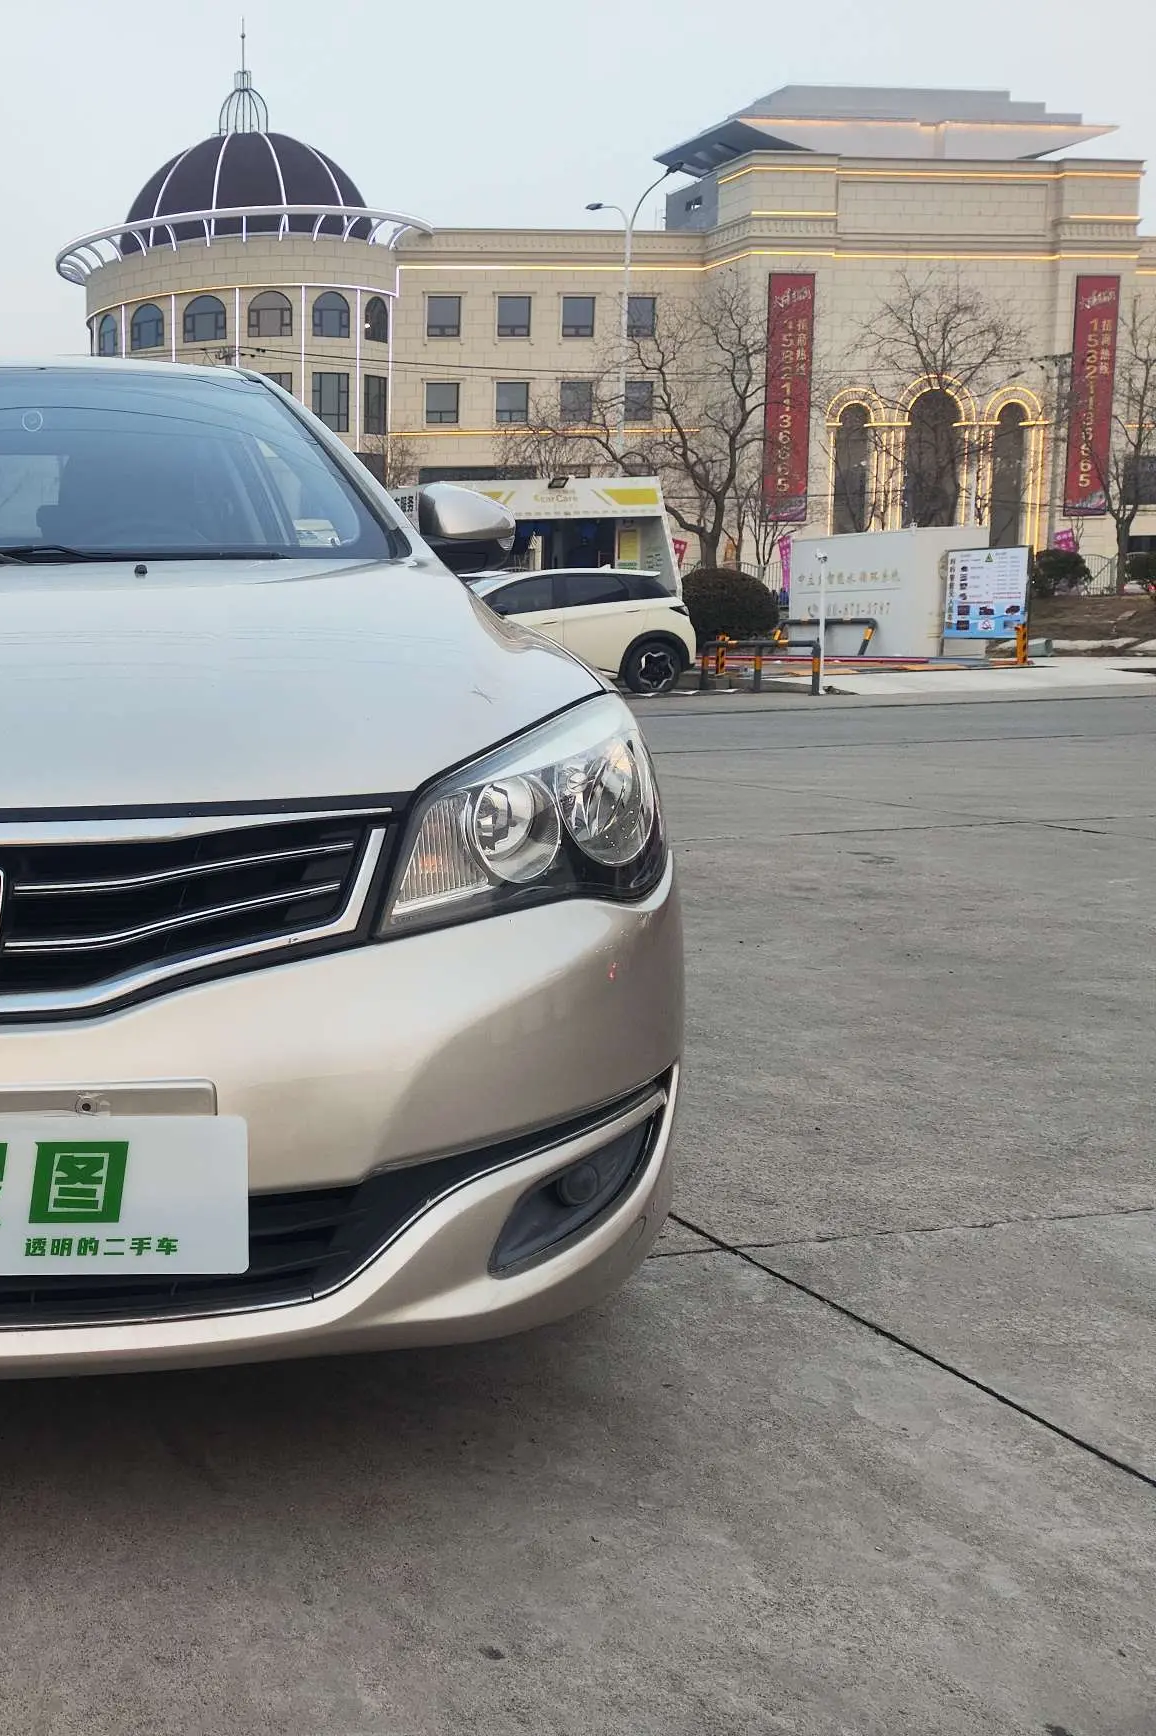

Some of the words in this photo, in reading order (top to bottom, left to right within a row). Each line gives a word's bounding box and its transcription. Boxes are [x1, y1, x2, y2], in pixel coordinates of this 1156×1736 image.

[23, 1236, 178, 1258] 透明的二手车
